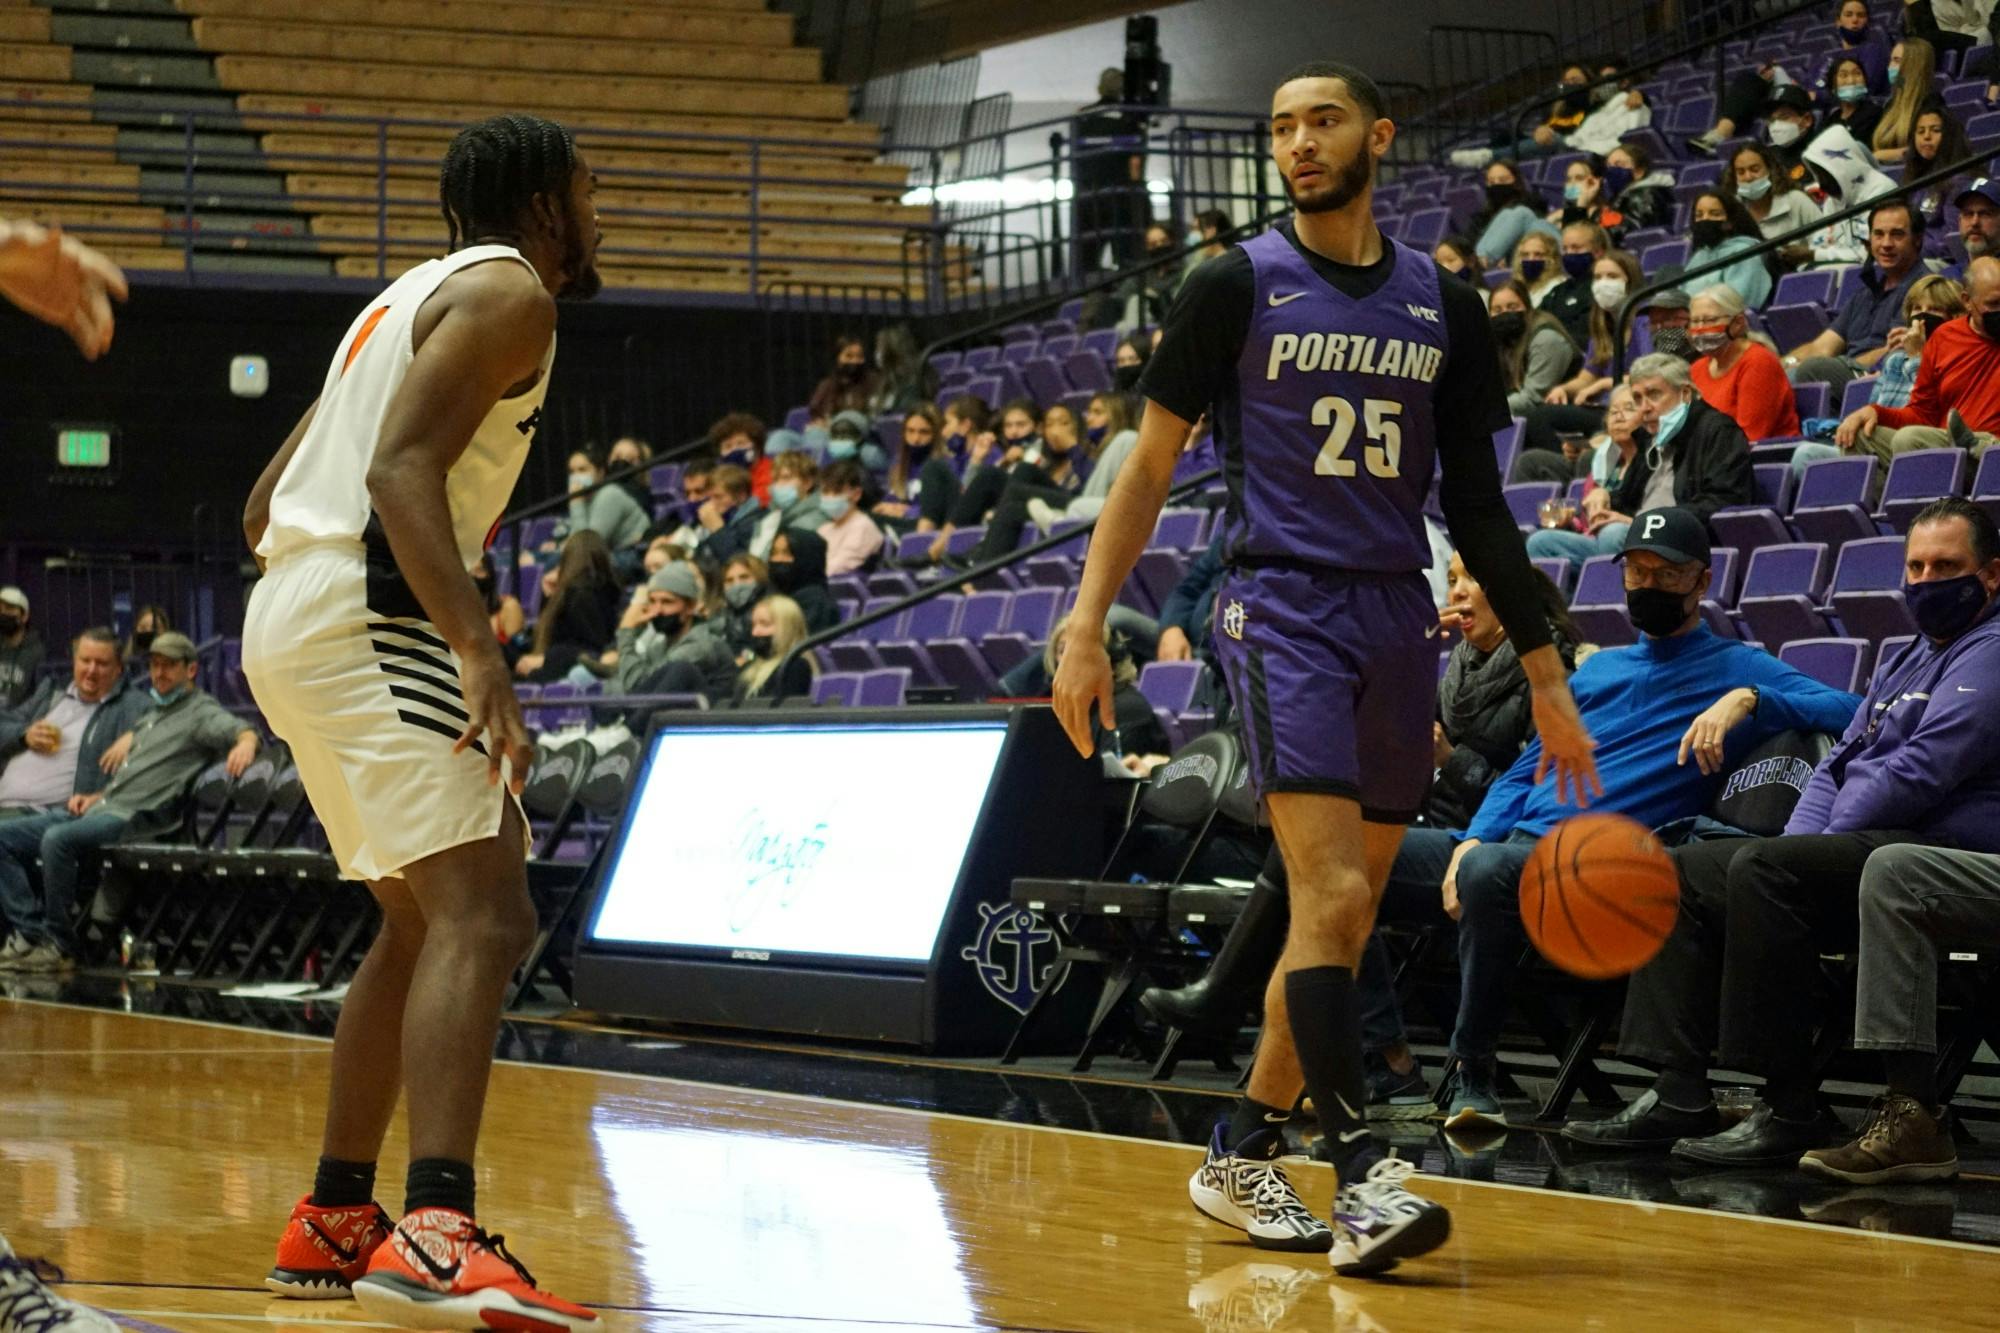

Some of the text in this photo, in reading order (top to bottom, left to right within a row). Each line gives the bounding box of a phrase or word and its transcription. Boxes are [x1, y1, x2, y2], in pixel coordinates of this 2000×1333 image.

[1266, 332, 1443, 383] PORTLAND
[1311, 396, 1402, 479] 25
[1642, 515, 1666, 539] P
[1721, 756, 1816, 801] PORTLAN
